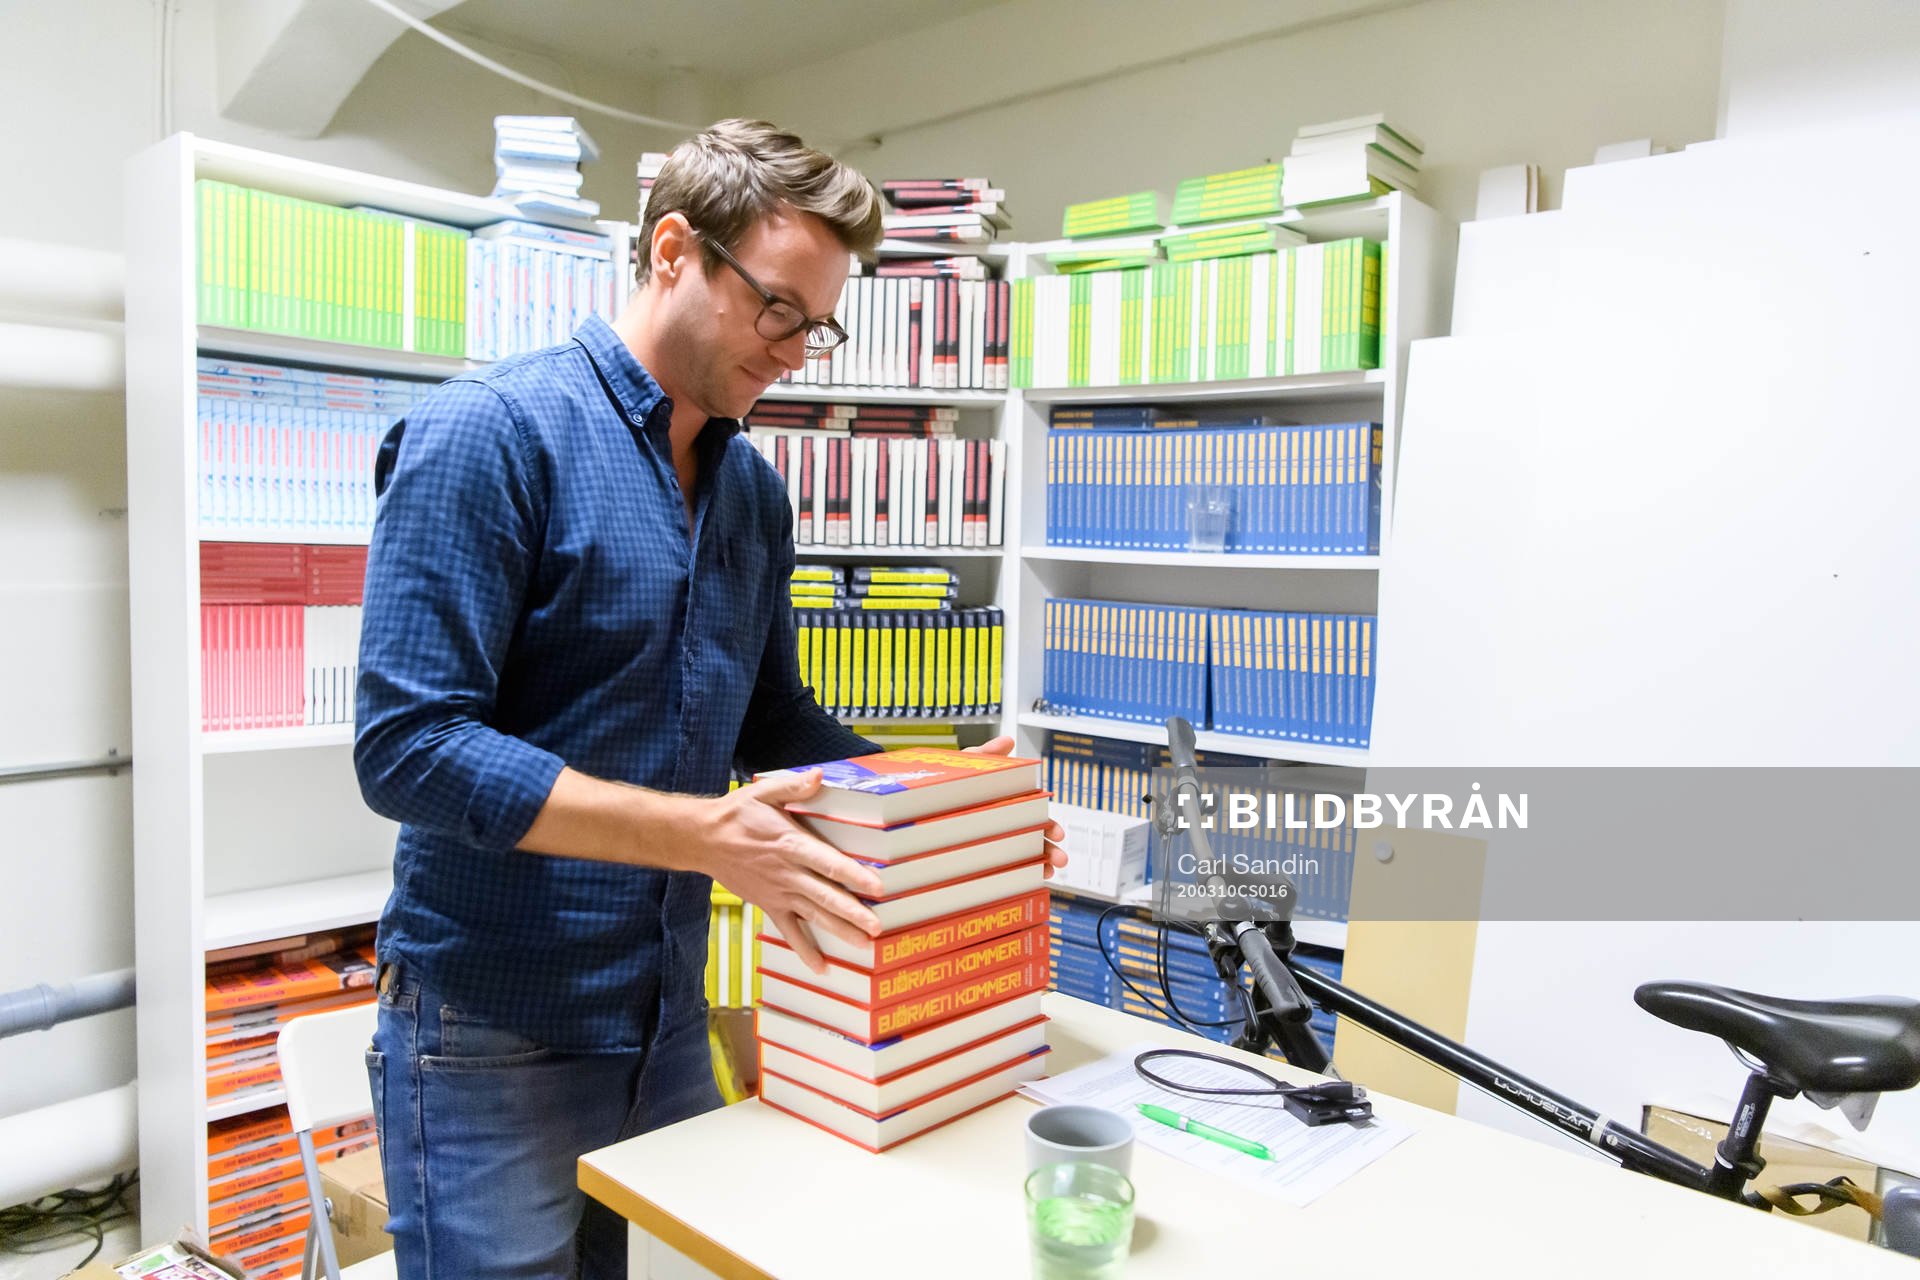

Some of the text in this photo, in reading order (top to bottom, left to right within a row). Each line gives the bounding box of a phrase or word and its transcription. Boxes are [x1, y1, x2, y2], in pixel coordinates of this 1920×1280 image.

[957, 905, 1022, 941] KOMMER!
[955, 938, 1021, 975] KOMMER!
[954, 970, 1022, 1008] KOMMER!
